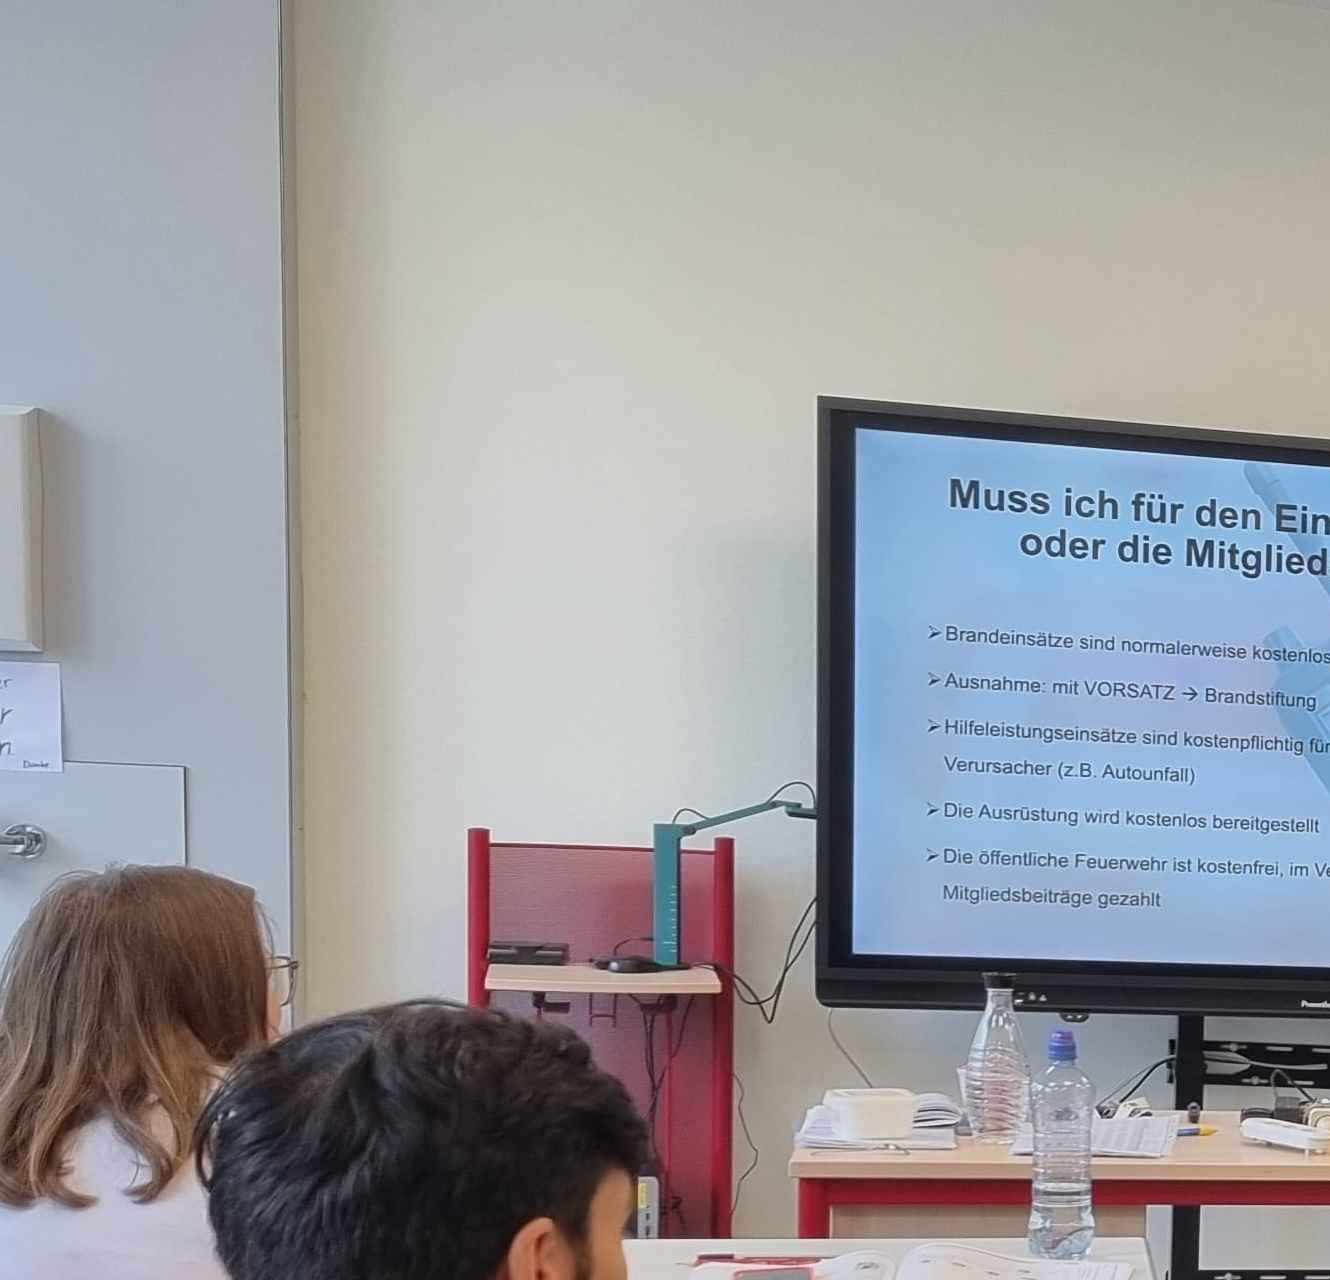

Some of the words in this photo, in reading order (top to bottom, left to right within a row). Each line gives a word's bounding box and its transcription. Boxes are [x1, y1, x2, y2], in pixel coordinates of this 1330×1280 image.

[949, 478, 1051, 515] Muss
[1063, 487, 1119, 519] ich
[1131, 493, 1184, 524] für
[1194, 499, 1262, 530] den
[1019, 529, 1106, 560] oder
[1117, 535, 1173, 565] die
[944, 626, 1074, 649] Brandeinsätze
[1079, 635, 1116, 651] sind
[1121, 640, 1248, 660] normalerweise
[944, 673, 1047, 694] Ausnahme:
[1052, 680, 1080, 696] mit
[1084, 681, 1176, 701] VORSATZ
[1205, 687, 1318, 712] Brandstiftung
[944, 719, 1137, 744] Hilfeleistungseinsätze
[1141, 730, 1178, 746] sind
[1183, 731, 1304, 756] kostenpflichtig
[944, 756, 1053, 777] Verursacher
[1057, 762, 1097, 780] (z.B.
[1102, 764, 1196, 786] Autounfall)
[943, 802, 974, 819] Die
[978, 804, 1079, 826] Ausrüstung
[1084, 809, 1121, 825] wird
[1126, 811, 1208, 829] kostenlos
[1212, 814, 1320, 835] bereitgestellt
[943, 848, 974, 865] Die
[978, 850, 1070, 869] öffentliche
[1075, 853, 1169, 873] Feuerwehr
[1172, 857, 1193, 873] ist
[1197, 858, 1284, 878] kostenfrei,
[1289, 862, 1310, 877] im
[943, 885, 1093, 909] Mitgliedsbeiträge
[1098, 890, 1162, 910] gezahlt
